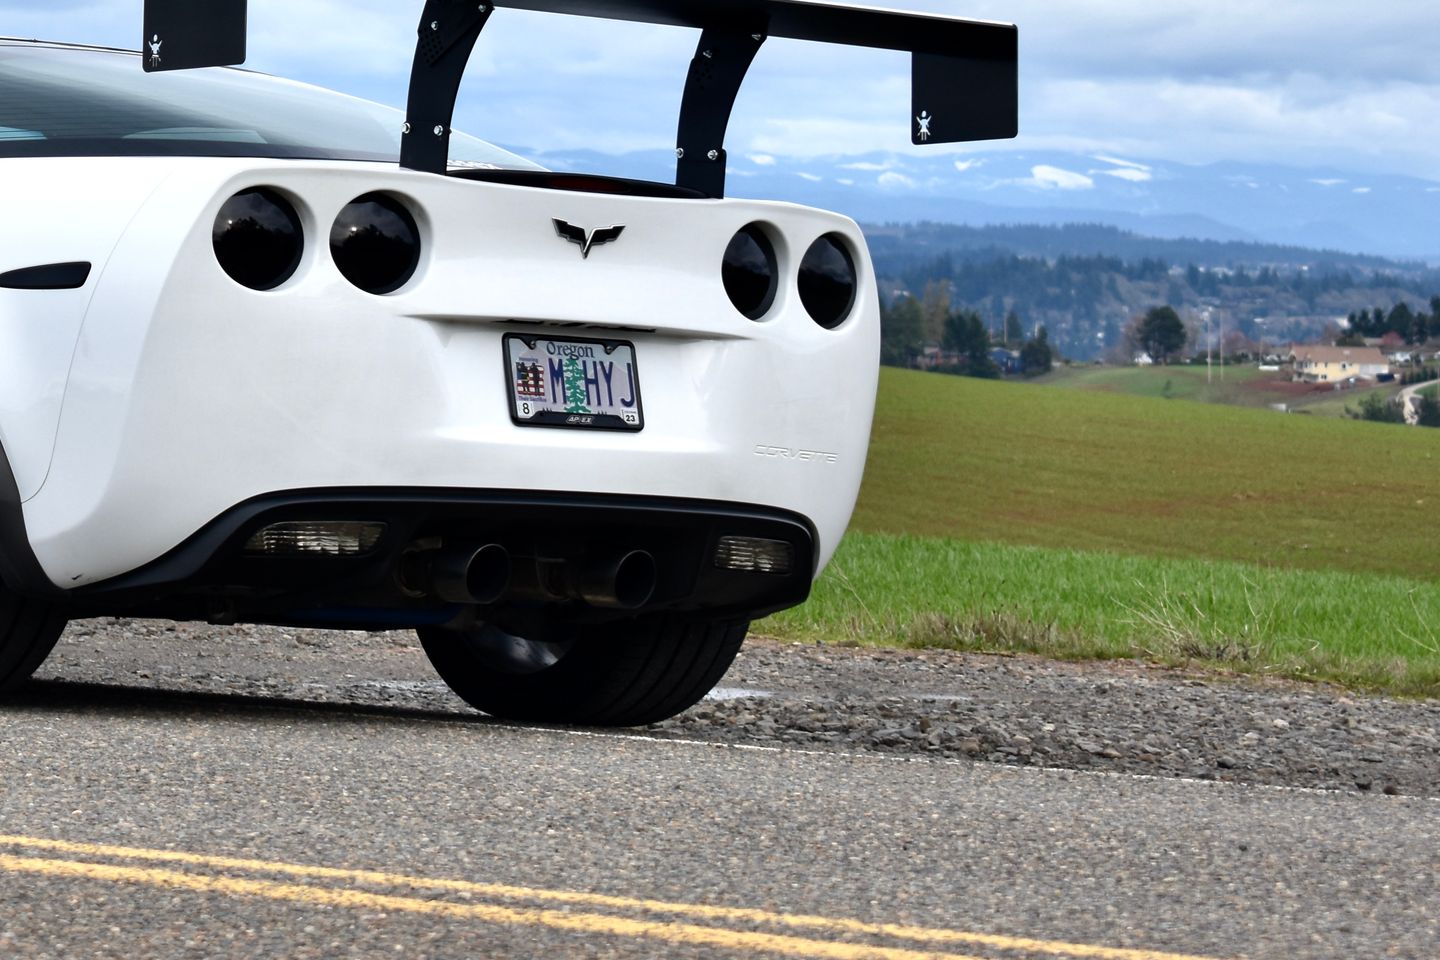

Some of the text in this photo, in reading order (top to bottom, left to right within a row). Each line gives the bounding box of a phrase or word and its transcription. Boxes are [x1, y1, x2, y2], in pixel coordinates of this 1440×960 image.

[546, 342, 594, 360] Oregon
[522, 402, 530, 414] 8
[625, 414, 635, 422] 23
[753, 444, 839, 464] CORVETTE
